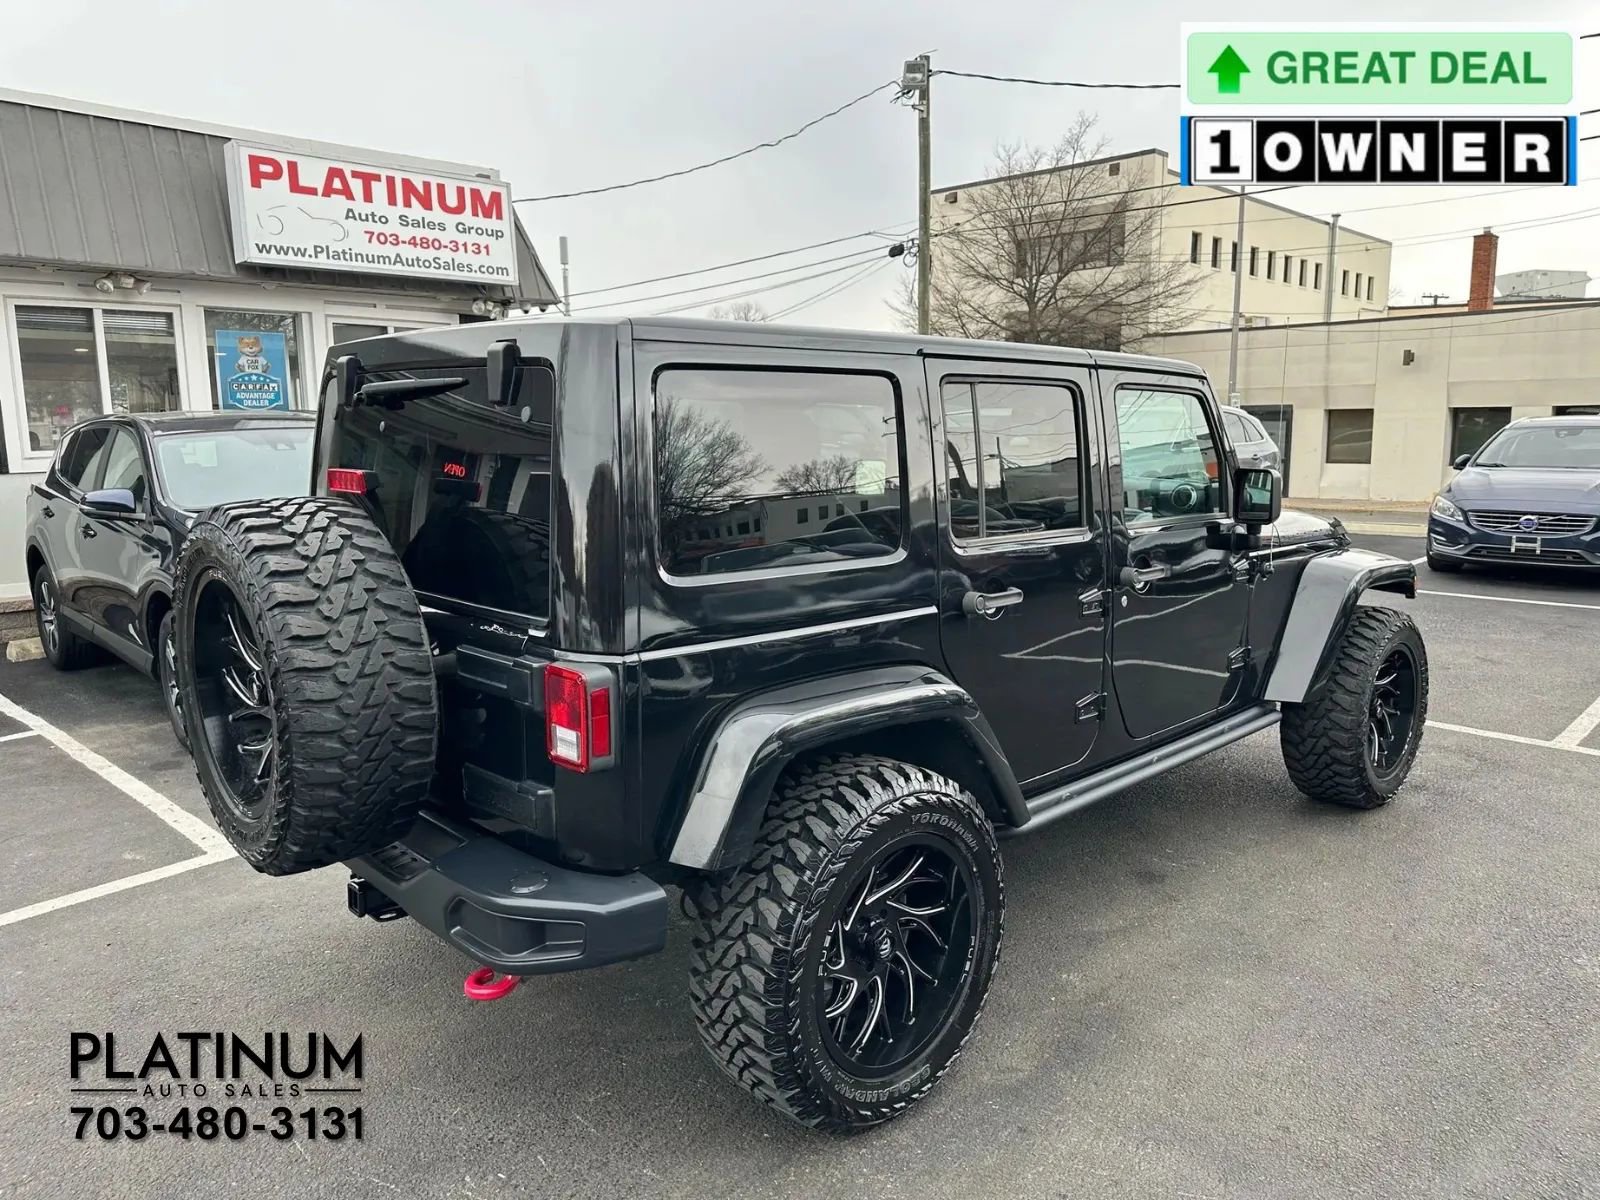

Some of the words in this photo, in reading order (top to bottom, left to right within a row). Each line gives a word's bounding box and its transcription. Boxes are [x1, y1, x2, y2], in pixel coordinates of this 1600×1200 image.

[248, 154, 504, 221] PLATINUM
[344, 208, 390, 225] Auto
[398, 214, 447, 232] Sales
[455, 222, 505, 241] Group
[254, 242, 509, 277] www.PlatinumAutoSales.com
[363, 230, 491, 256] 703-480-3131
[232, 383, 278, 391] CARFAX
